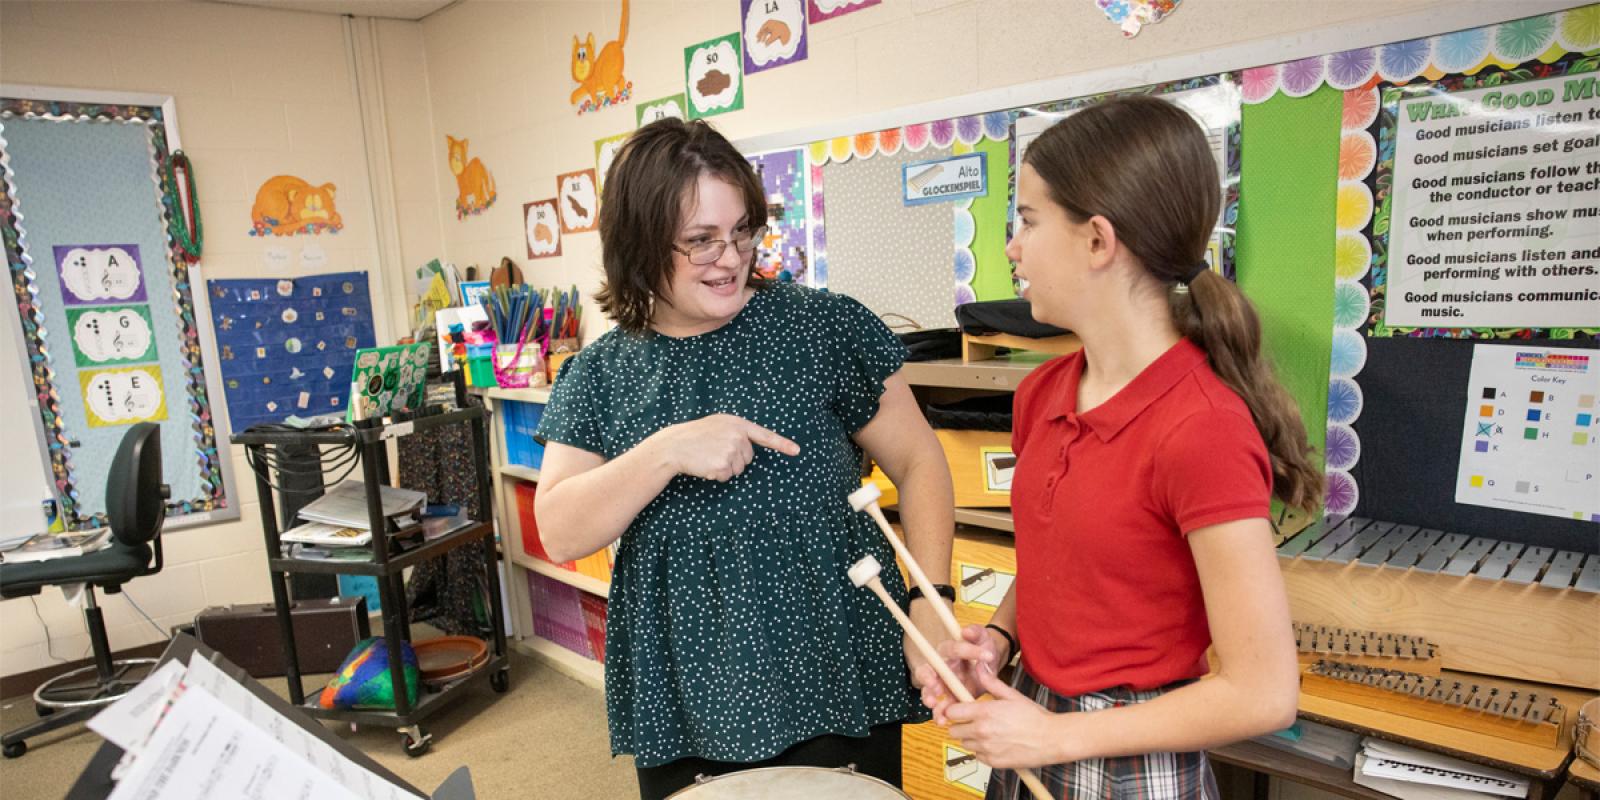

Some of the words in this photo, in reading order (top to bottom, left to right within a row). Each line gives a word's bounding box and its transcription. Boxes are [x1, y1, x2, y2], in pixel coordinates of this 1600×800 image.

[764, 0, 779, 14] LA
[706, 52, 719, 64] SO
[1416, 126, 1451, 141] Good
[1455, 117, 1531, 137] musicians
[1536, 111, 1582, 127] listen
[1414, 150, 1449, 165] Good
[1453, 143, 1528, 161] musicians
[1533, 139, 1558, 153] set
[958, 165, 979, 178] Alto
[1412, 175, 1447, 189] Good
[1451, 169, 1525, 187] musicians
[1530, 164, 1581, 180] follow
[922, 180, 980, 196] GLOCKENSPIEL
[1429, 190, 1452, 203] the
[1456, 185, 1531, 200] conductor
[1535, 184, 1552, 195] or
[1409, 215, 1444, 228] Good
[1447, 210, 1521, 226] musicians
[1526, 207, 1567, 221] show
[1572, 206, 1600, 218] mu
[1427, 229, 1463, 241] when
[1467, 224, 1554, 242] performing.
[108, 255, 119, 267] A
[1407, 253, 1441, 265] Good
[1444, 249, 1517, 265] musicians
[1521, 249, 1566, 261] listen
[1571, 248, 1600, 260] and
[1423, 267, 1500, 281] performing
[1504, 265, 1537, 277] with
[1542, 264, 1599, 277] others.
[1405, 291, 1438, 303] Good
[1441, 290, 1513, 303] musicians
[1518, 288, 1600, 302] communic
[1420, 306, 1464, 317] music.
[119, 315, 130, 328] G
[131, 376, 141, 389] E
[1531, 375, 1551, 383] Color
[1552, 376, 1567, 384] Key
